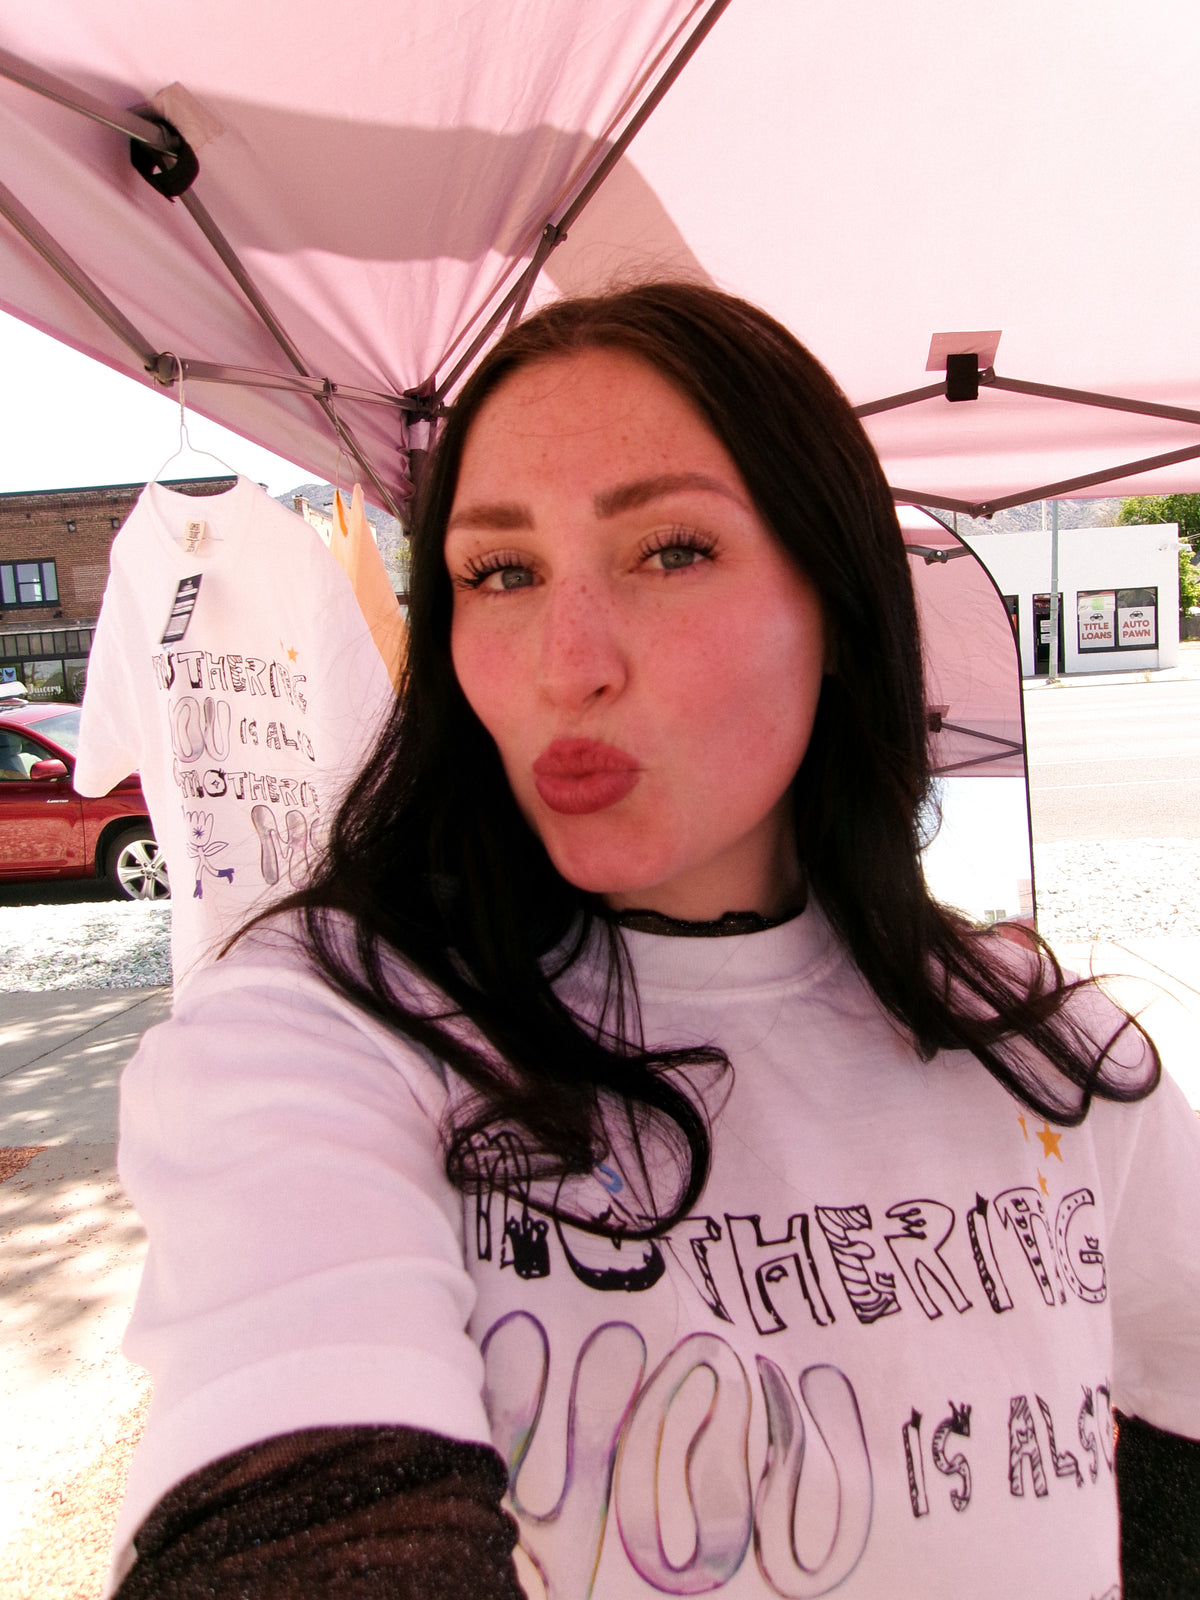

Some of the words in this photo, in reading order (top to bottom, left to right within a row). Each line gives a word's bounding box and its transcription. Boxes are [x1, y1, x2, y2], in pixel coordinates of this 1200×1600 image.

[1083, 622, 1109, 631] TITLE
[1122, 619, 1150, 629] AUTO
[1081, 631, 1112, 640] LOANS
[1122, 629, 1151, 638] PAWN
[240, 717, 259, 745] IS
[902, 1400, 972, 1517] IS
